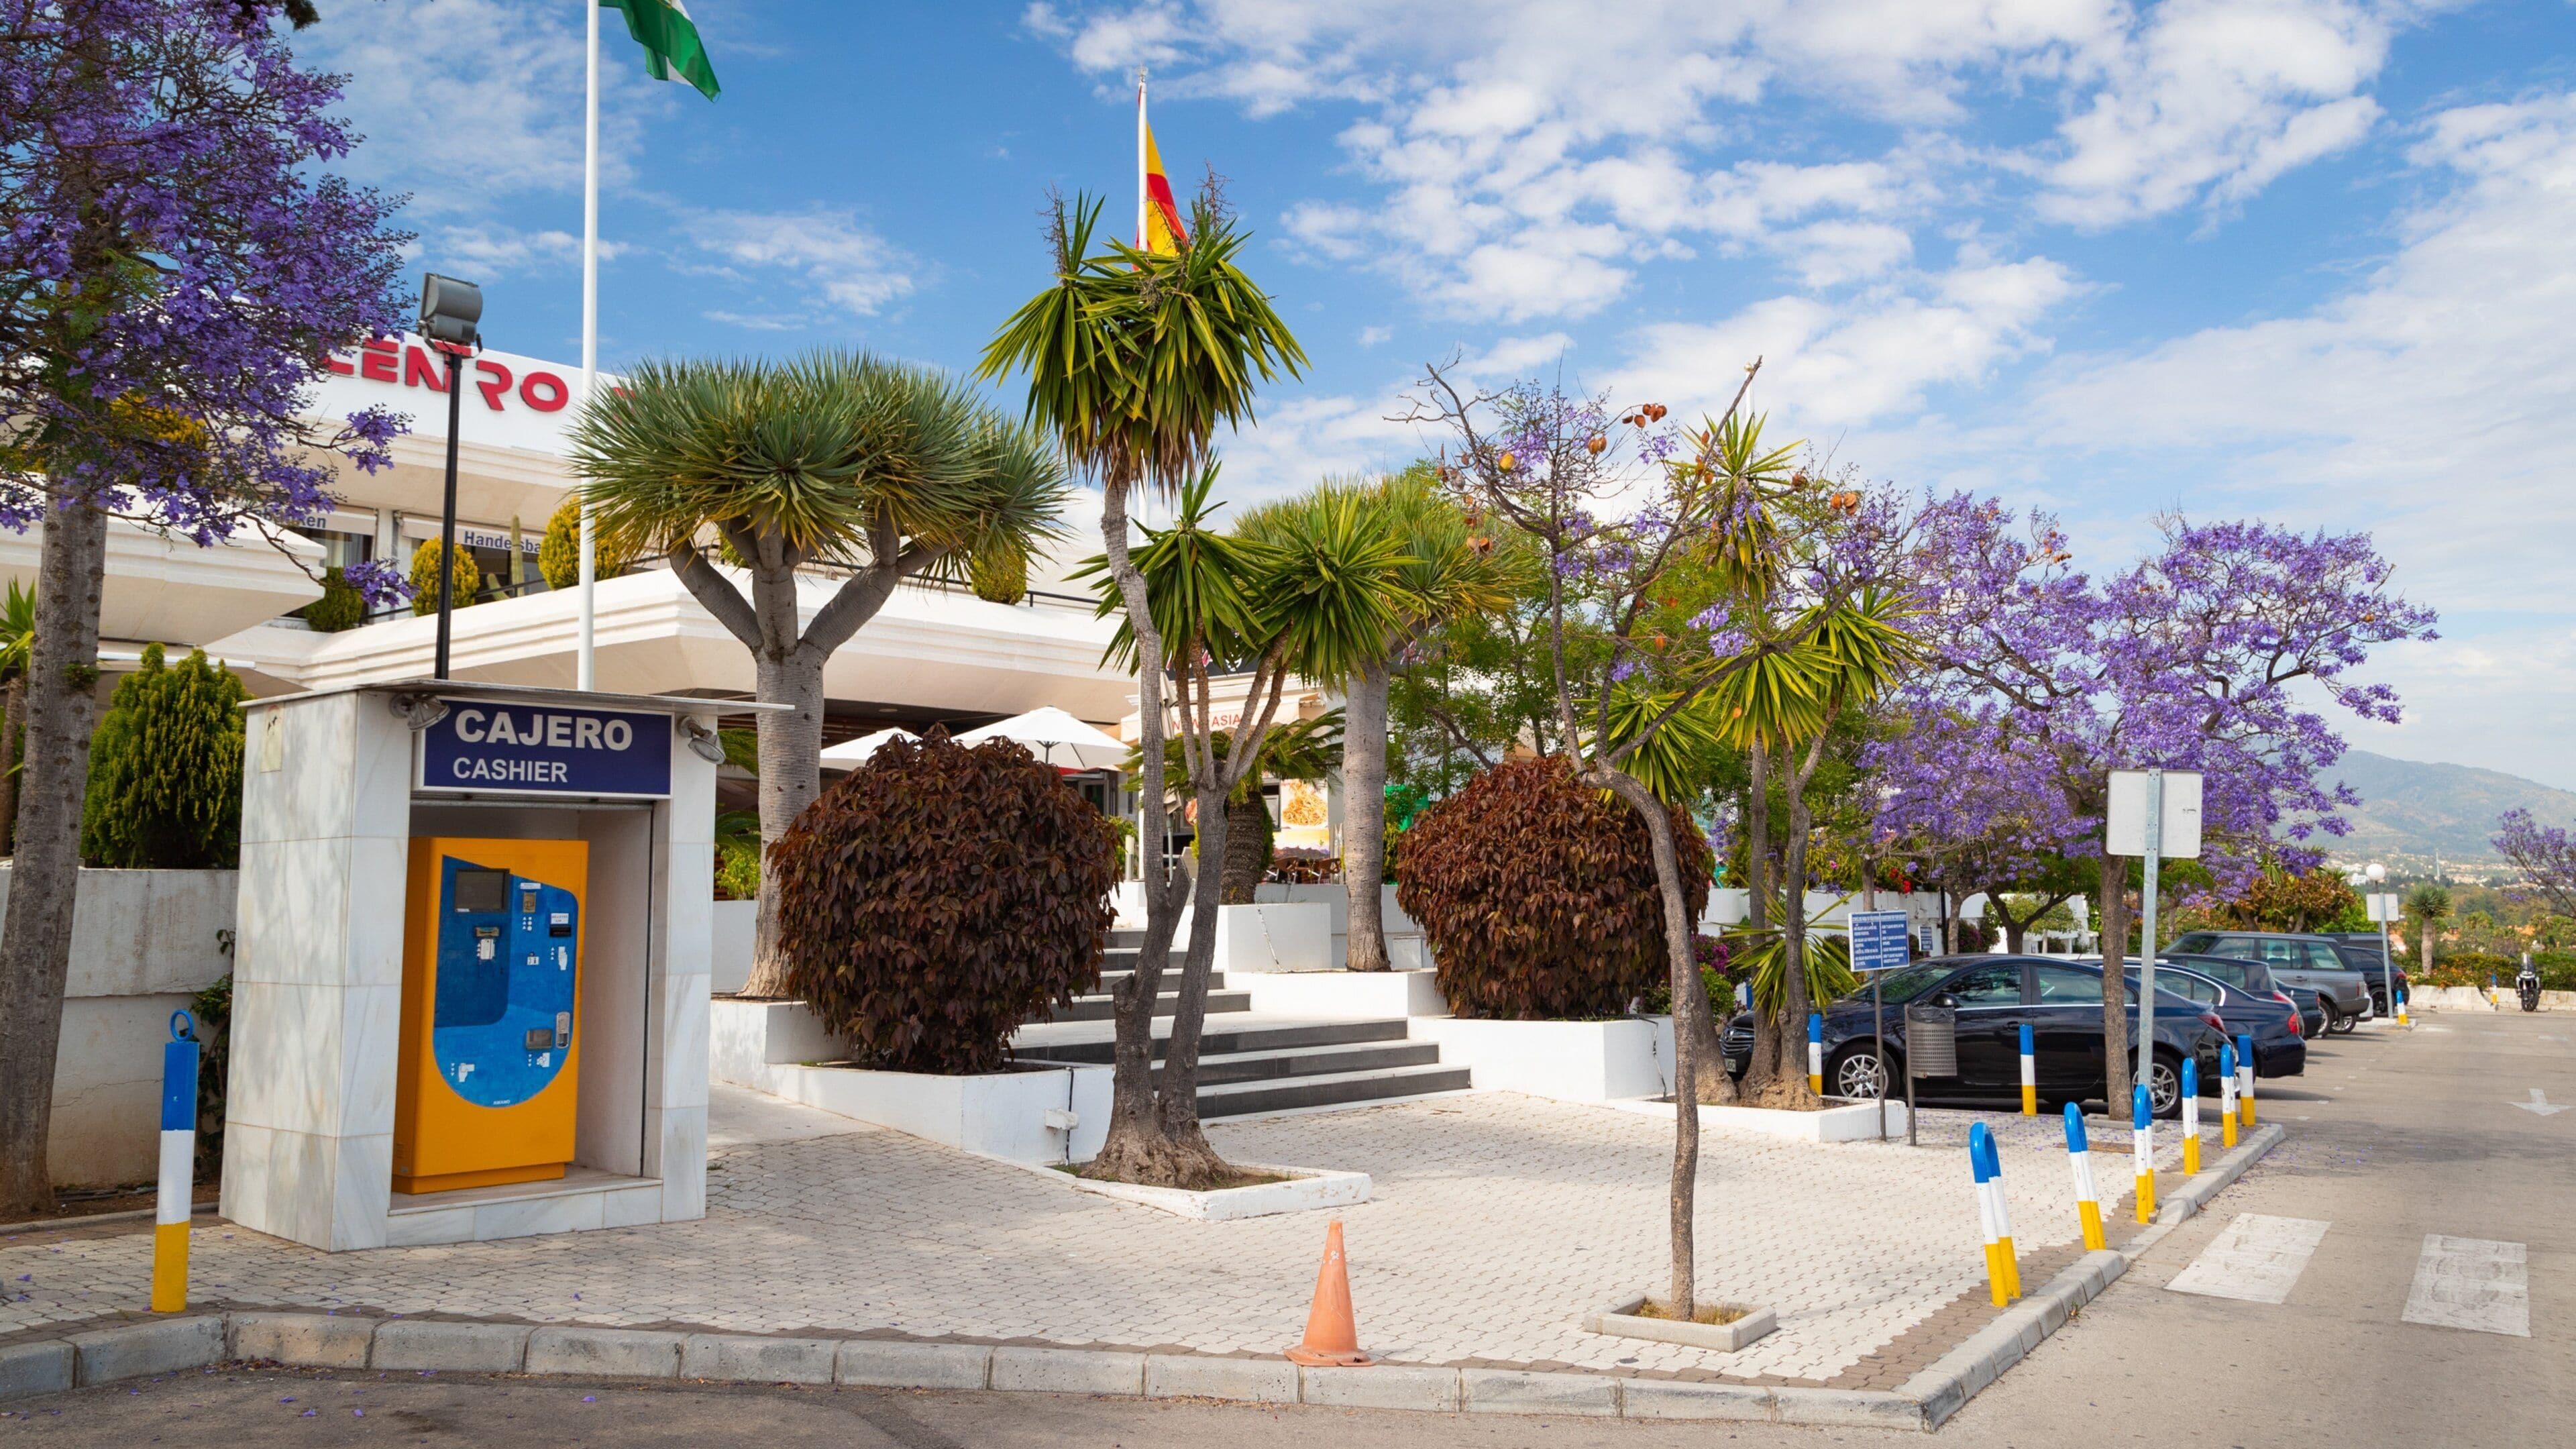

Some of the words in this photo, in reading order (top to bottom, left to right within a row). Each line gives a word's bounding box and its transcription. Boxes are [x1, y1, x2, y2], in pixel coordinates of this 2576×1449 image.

[464, 531, 541, 553] Handesba
[455, 709, 633, 751] CAJERO
[1171, 718, 1200, 731] NW
[1212, 713, 1241, 728] ASIA
[453, 757, 568, 783] CASHIER
